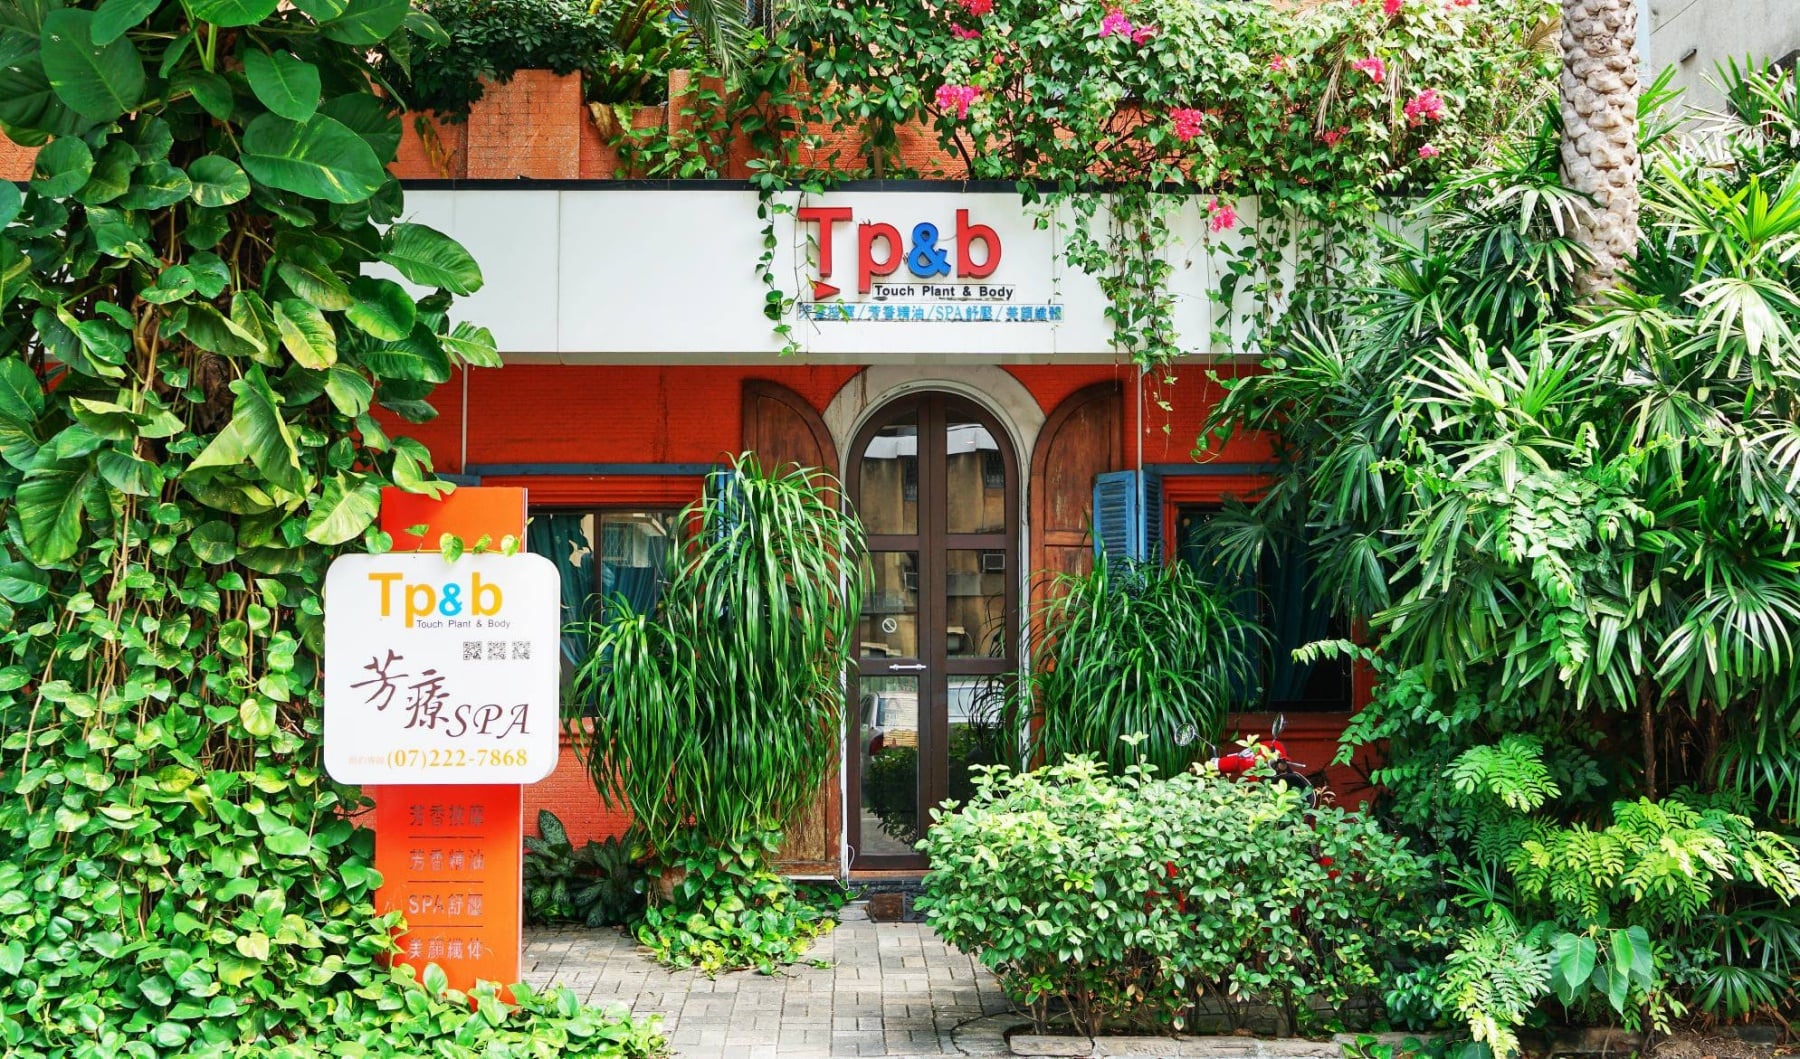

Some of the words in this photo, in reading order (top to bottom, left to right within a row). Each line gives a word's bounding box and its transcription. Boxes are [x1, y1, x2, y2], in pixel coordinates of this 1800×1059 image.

[797, 206, 1002, 294] Tp&b
[875, 285, 914, 297] Touch
[922, 286, 955, 297] Plant
[962, 286, 971, 297] &
[979, 286, 1013, 301] Body
[368, 572, 503, 628] Tp&b
[416, 619, 443, 628] Touch
[448, 619, 471, 628] Plant
[476, 619, 482, 628] &
[488, 619, 510, 629] Body
[387, 748, 528, 769] (07)222-7868
[409, 848, 485, 872] 芳香精油
